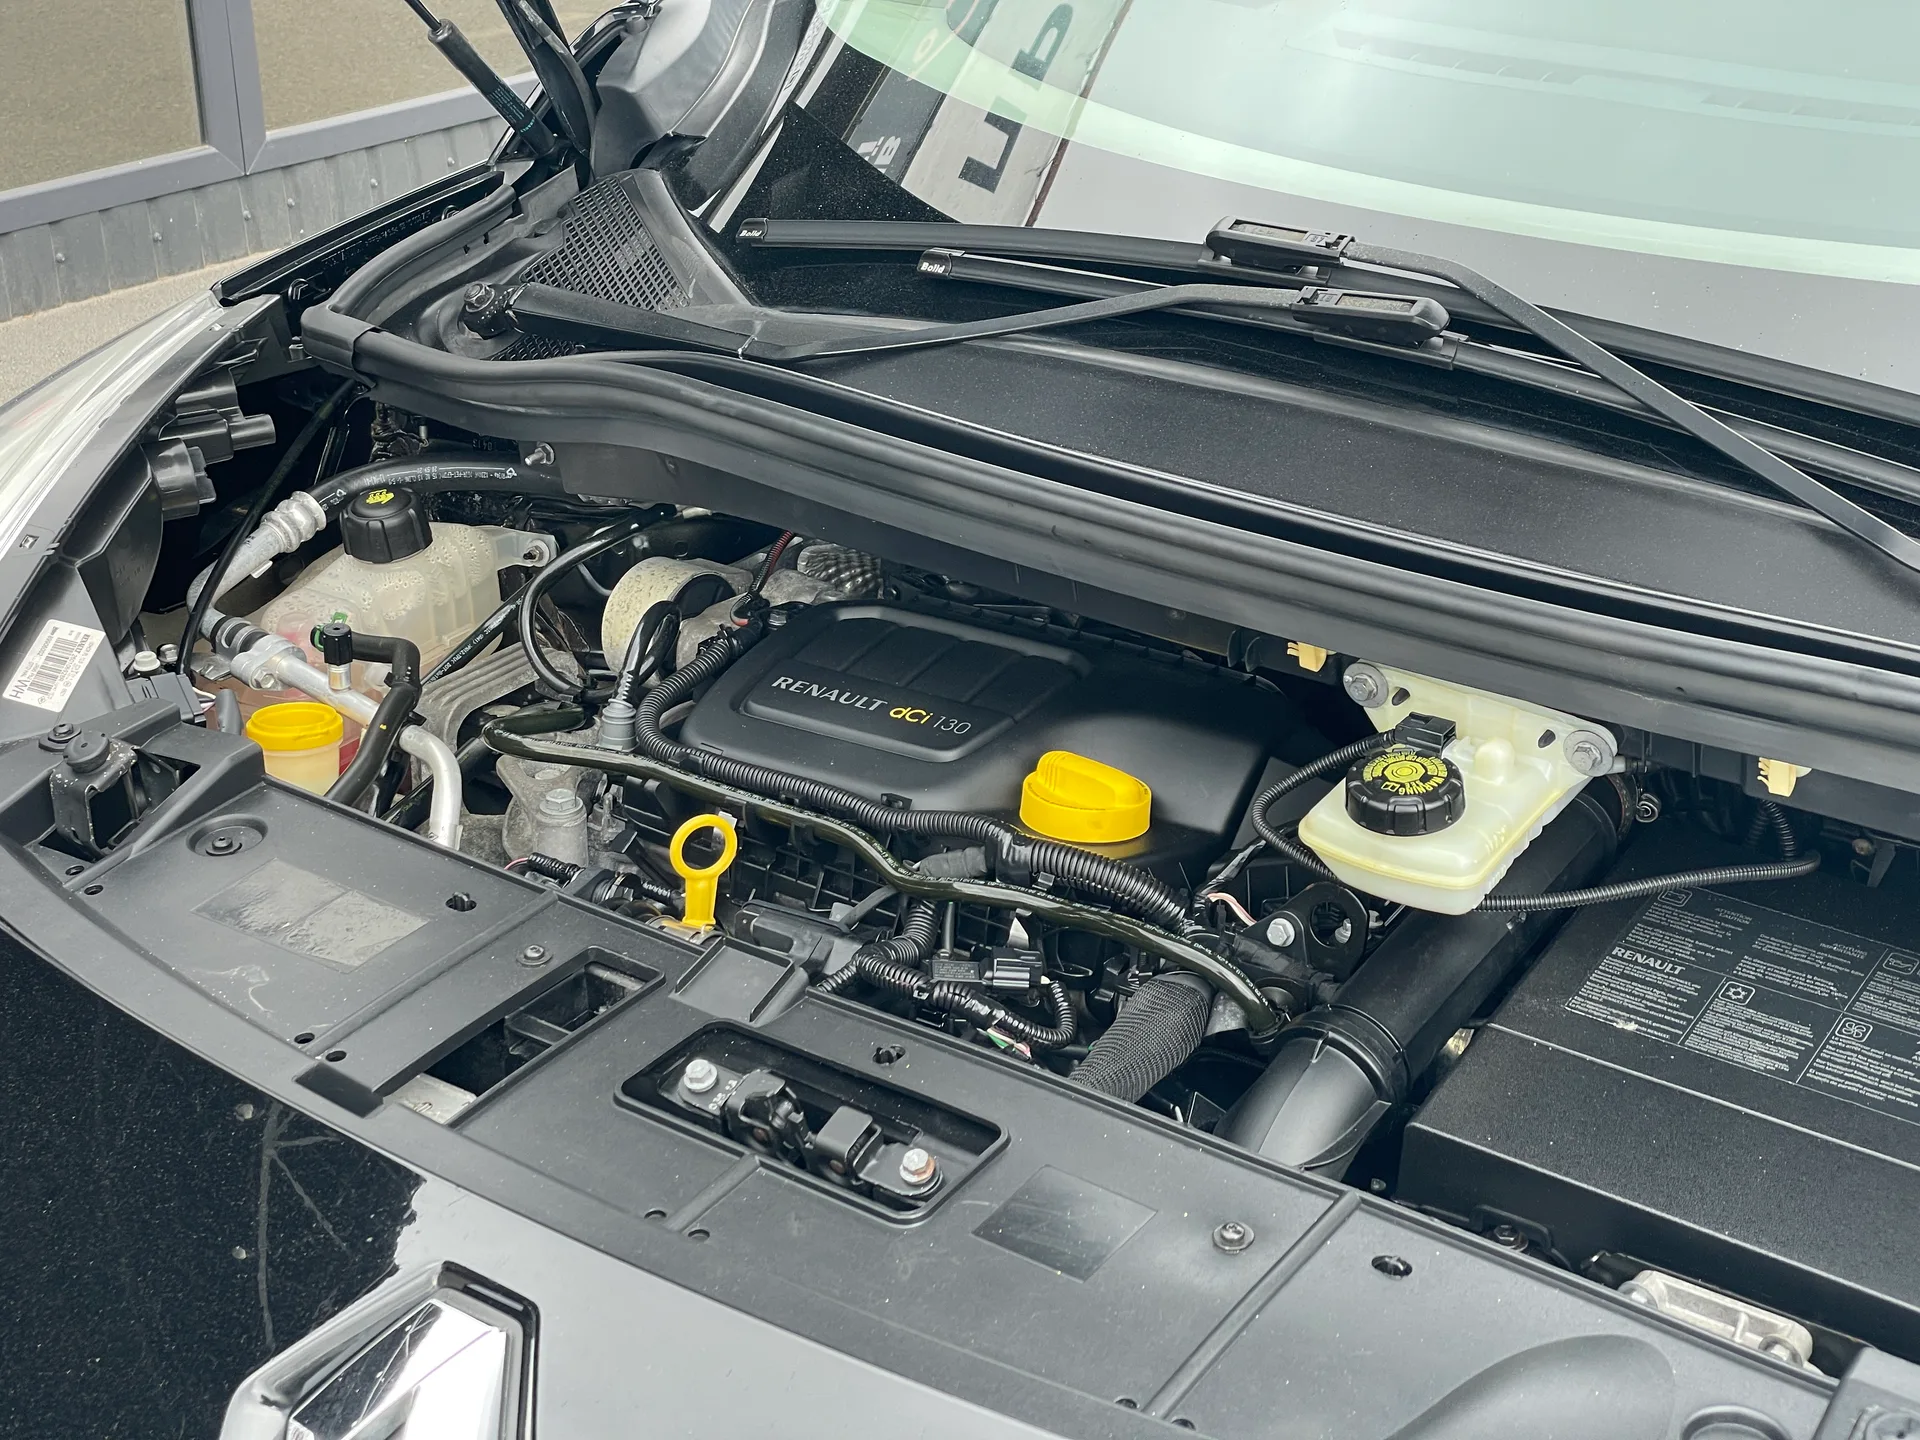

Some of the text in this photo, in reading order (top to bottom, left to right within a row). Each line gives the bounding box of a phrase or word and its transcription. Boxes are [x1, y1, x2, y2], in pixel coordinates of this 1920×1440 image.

[920, 261, 946, 274] Bolid
[771, 676, 972, 735] RENAULT dCi 130
[1398, 776, 1445, 795] WARNING
[1611, 946, 1686, 975] RENAULT
